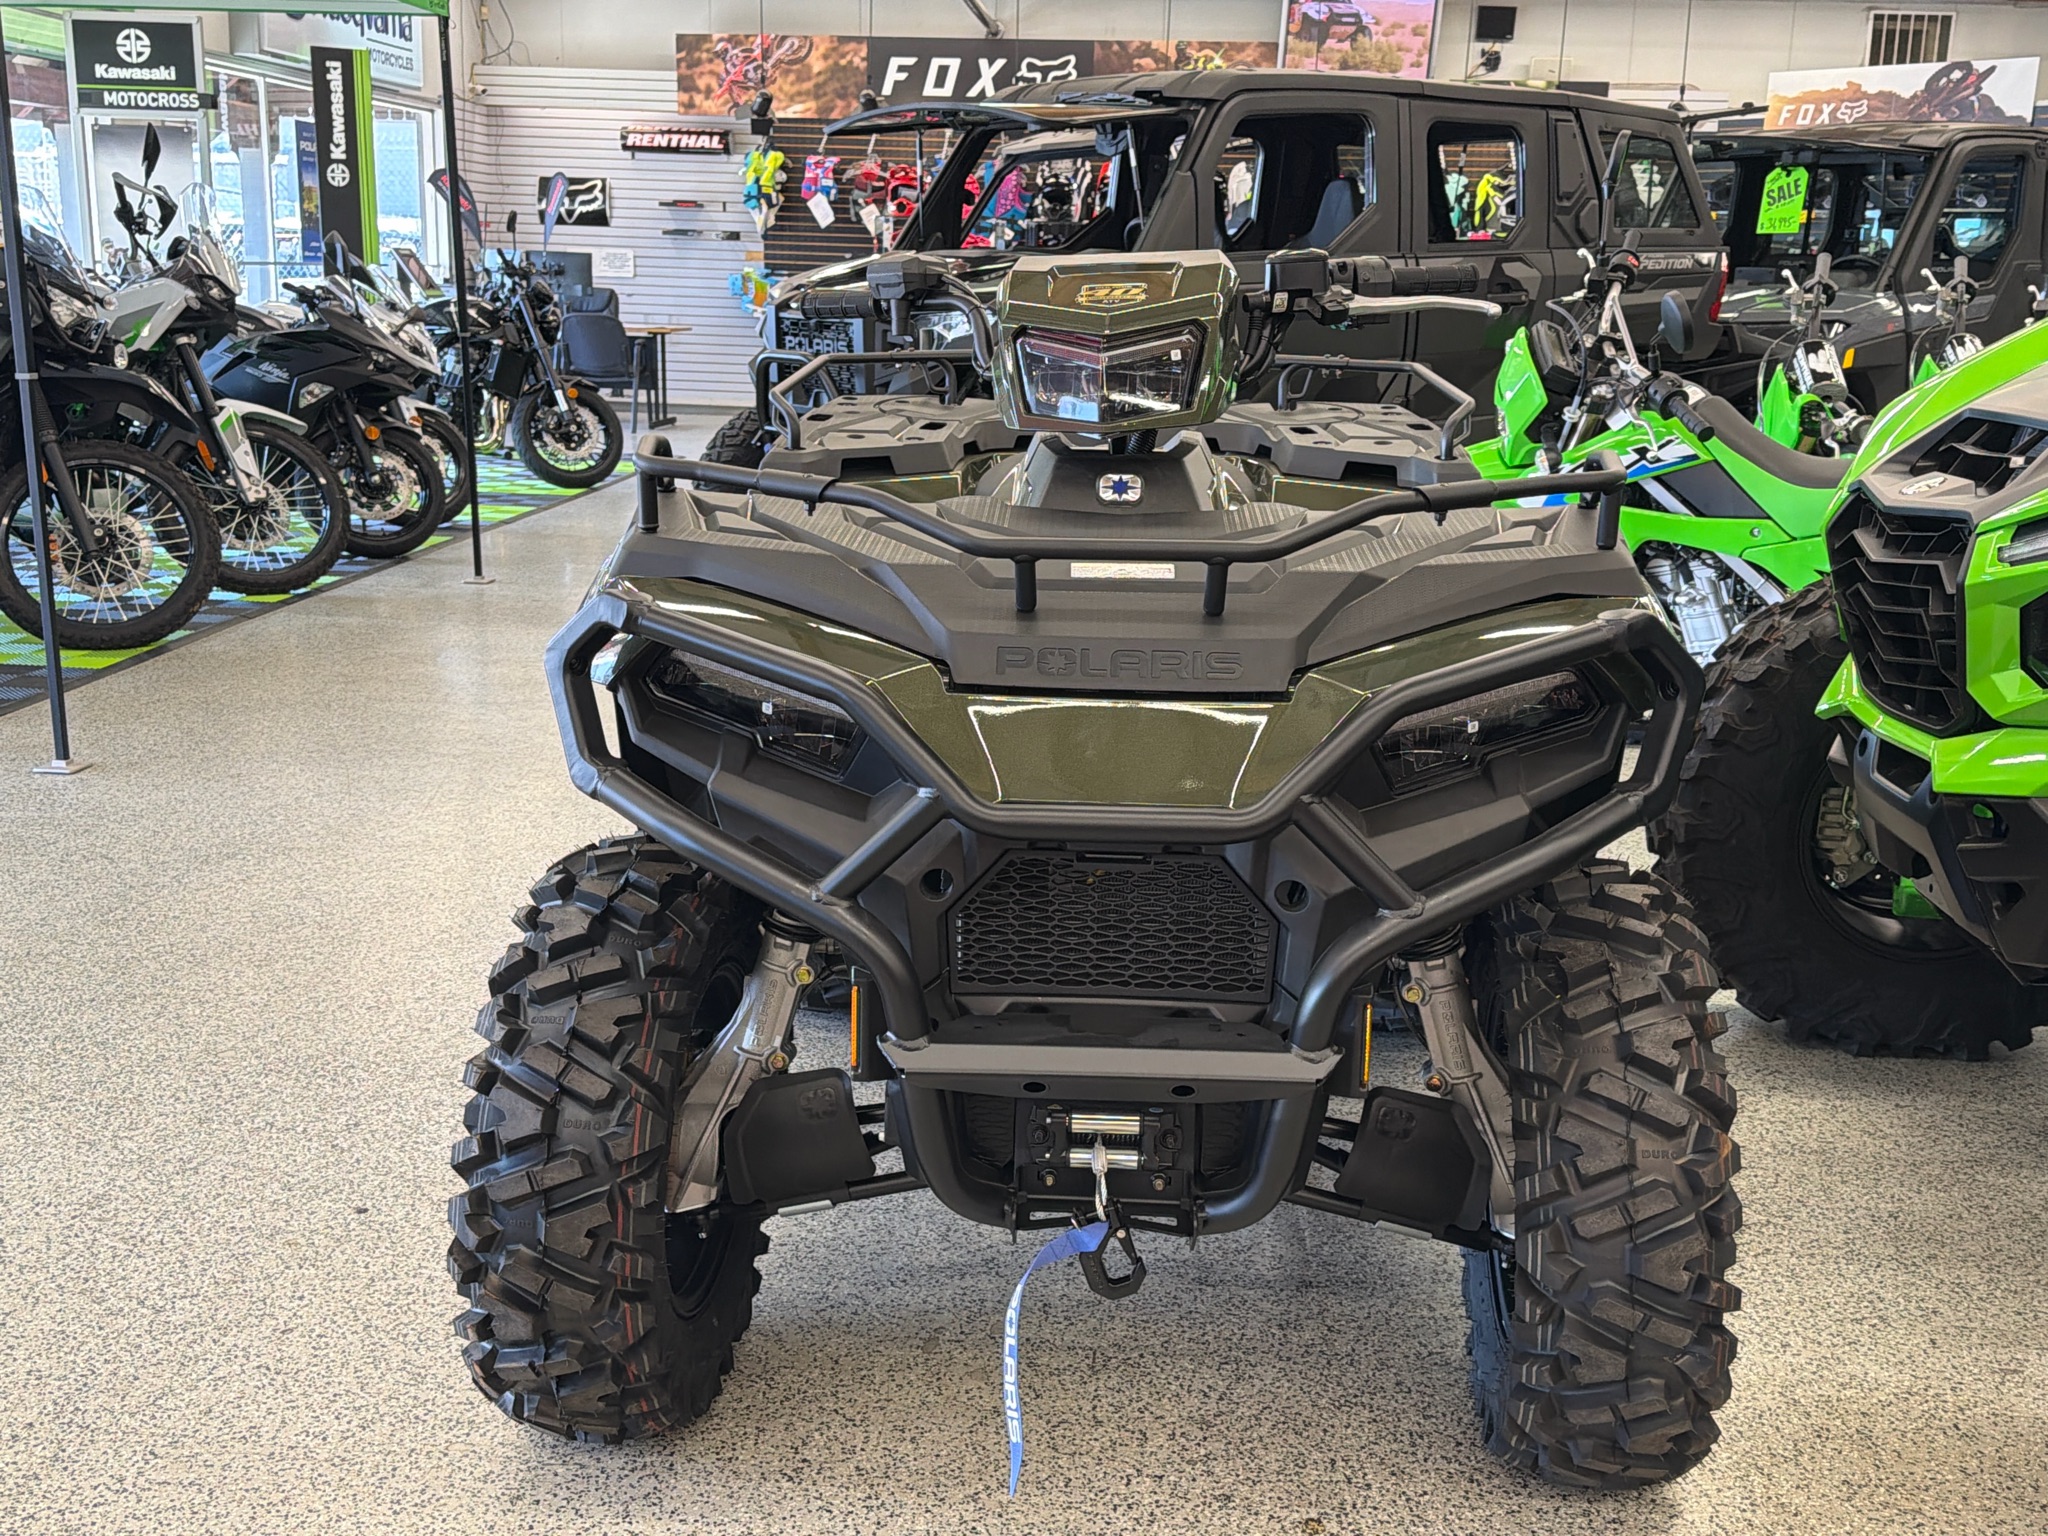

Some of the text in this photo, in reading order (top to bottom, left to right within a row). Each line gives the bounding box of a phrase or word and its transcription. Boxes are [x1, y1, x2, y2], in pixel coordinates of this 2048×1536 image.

[94, 63, 177, 81] Kawasaki
[881, 56, 1008, 98] FOX
[103, 90, 200, 108] MOTOCROSS
[325, 60, 347, 160] Kawasaki
[1777, 102, 1837, 126] FOX
[626, 133, 726, 149] RENTHAL
[1766, 178, 1803, 207] SALE
[1640, 255, 1694, 270] PEDITION
[784, 335, 849, 354] POLARIS
[258, 361, 291, 380] Ninja
[996, 646, 1244, 681] POLARIS
[1439, 1000, 1467, 1071] POLARIS
[563, 1118, 602, 1131] DURO
[1641, 1149, 1679, 1160] DURO
[1003, 1284, 1024, 1444] POLARIS
